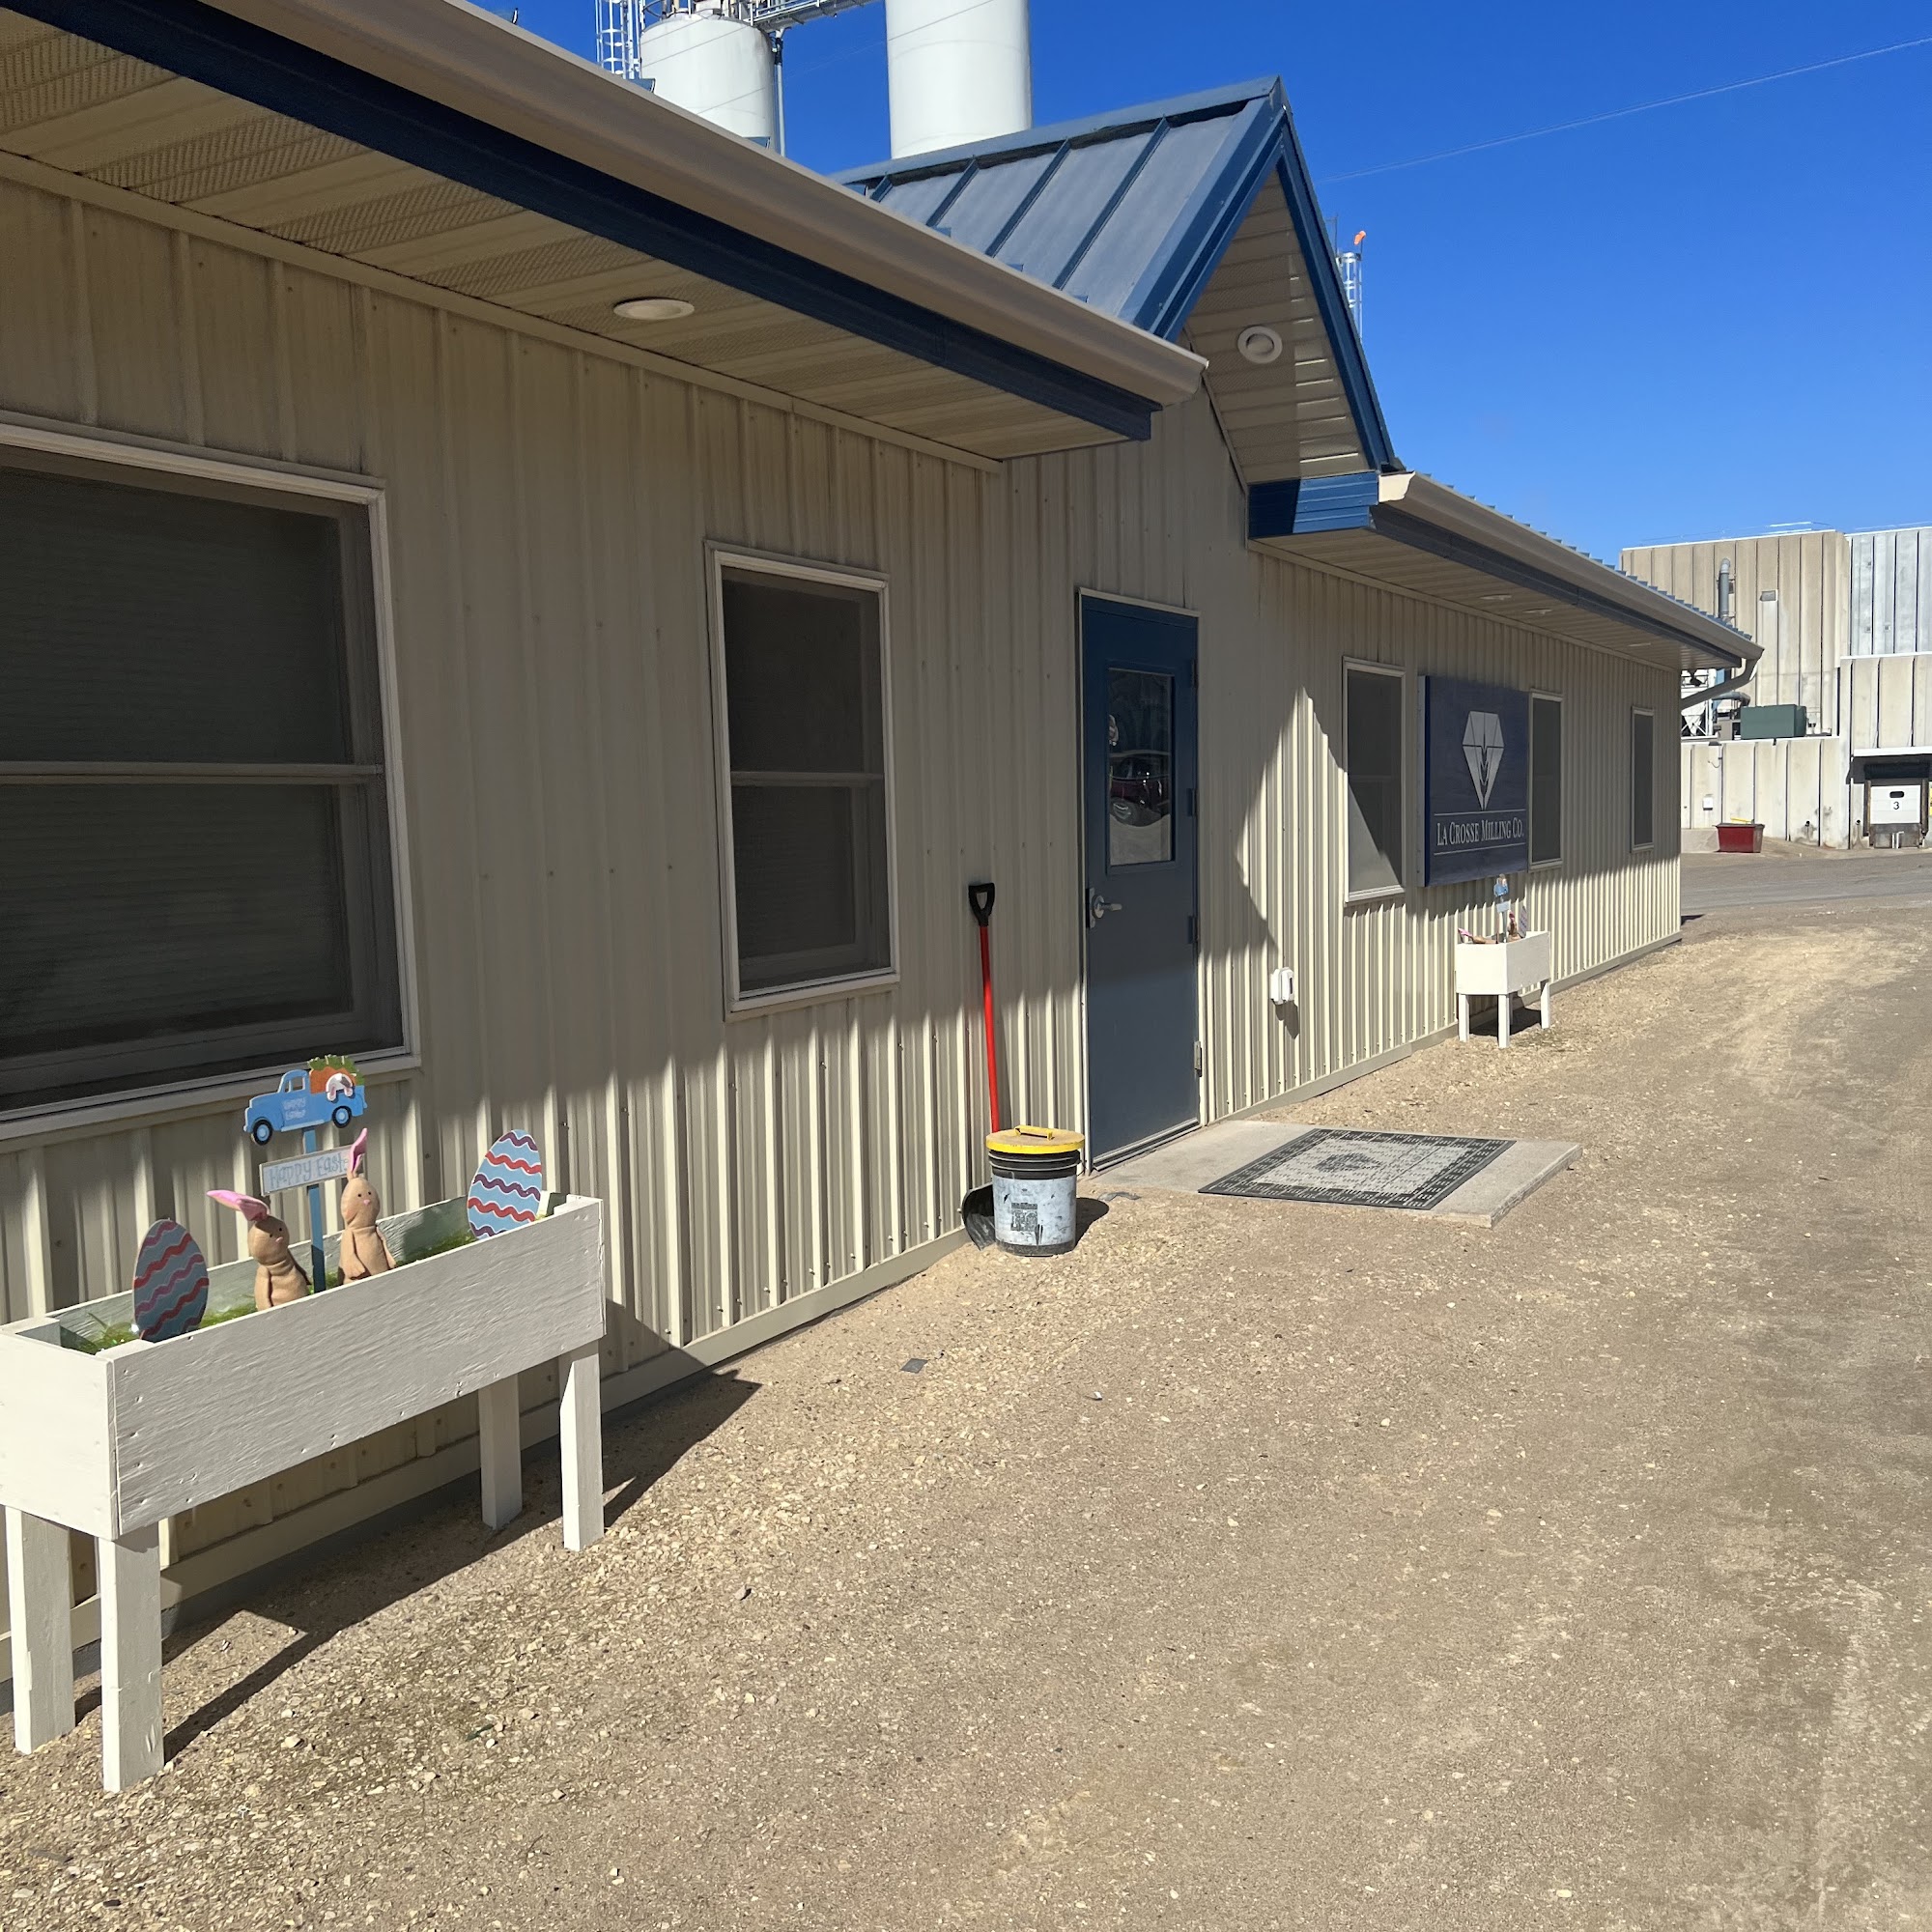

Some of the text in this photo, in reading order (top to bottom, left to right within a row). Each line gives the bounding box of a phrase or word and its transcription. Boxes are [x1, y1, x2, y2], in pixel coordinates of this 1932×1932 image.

[1892, 801, 1900, 810] 3
[1449, 821, 1480, 845] CROSSE
[1481, 819, 1512, 842] MILLING
